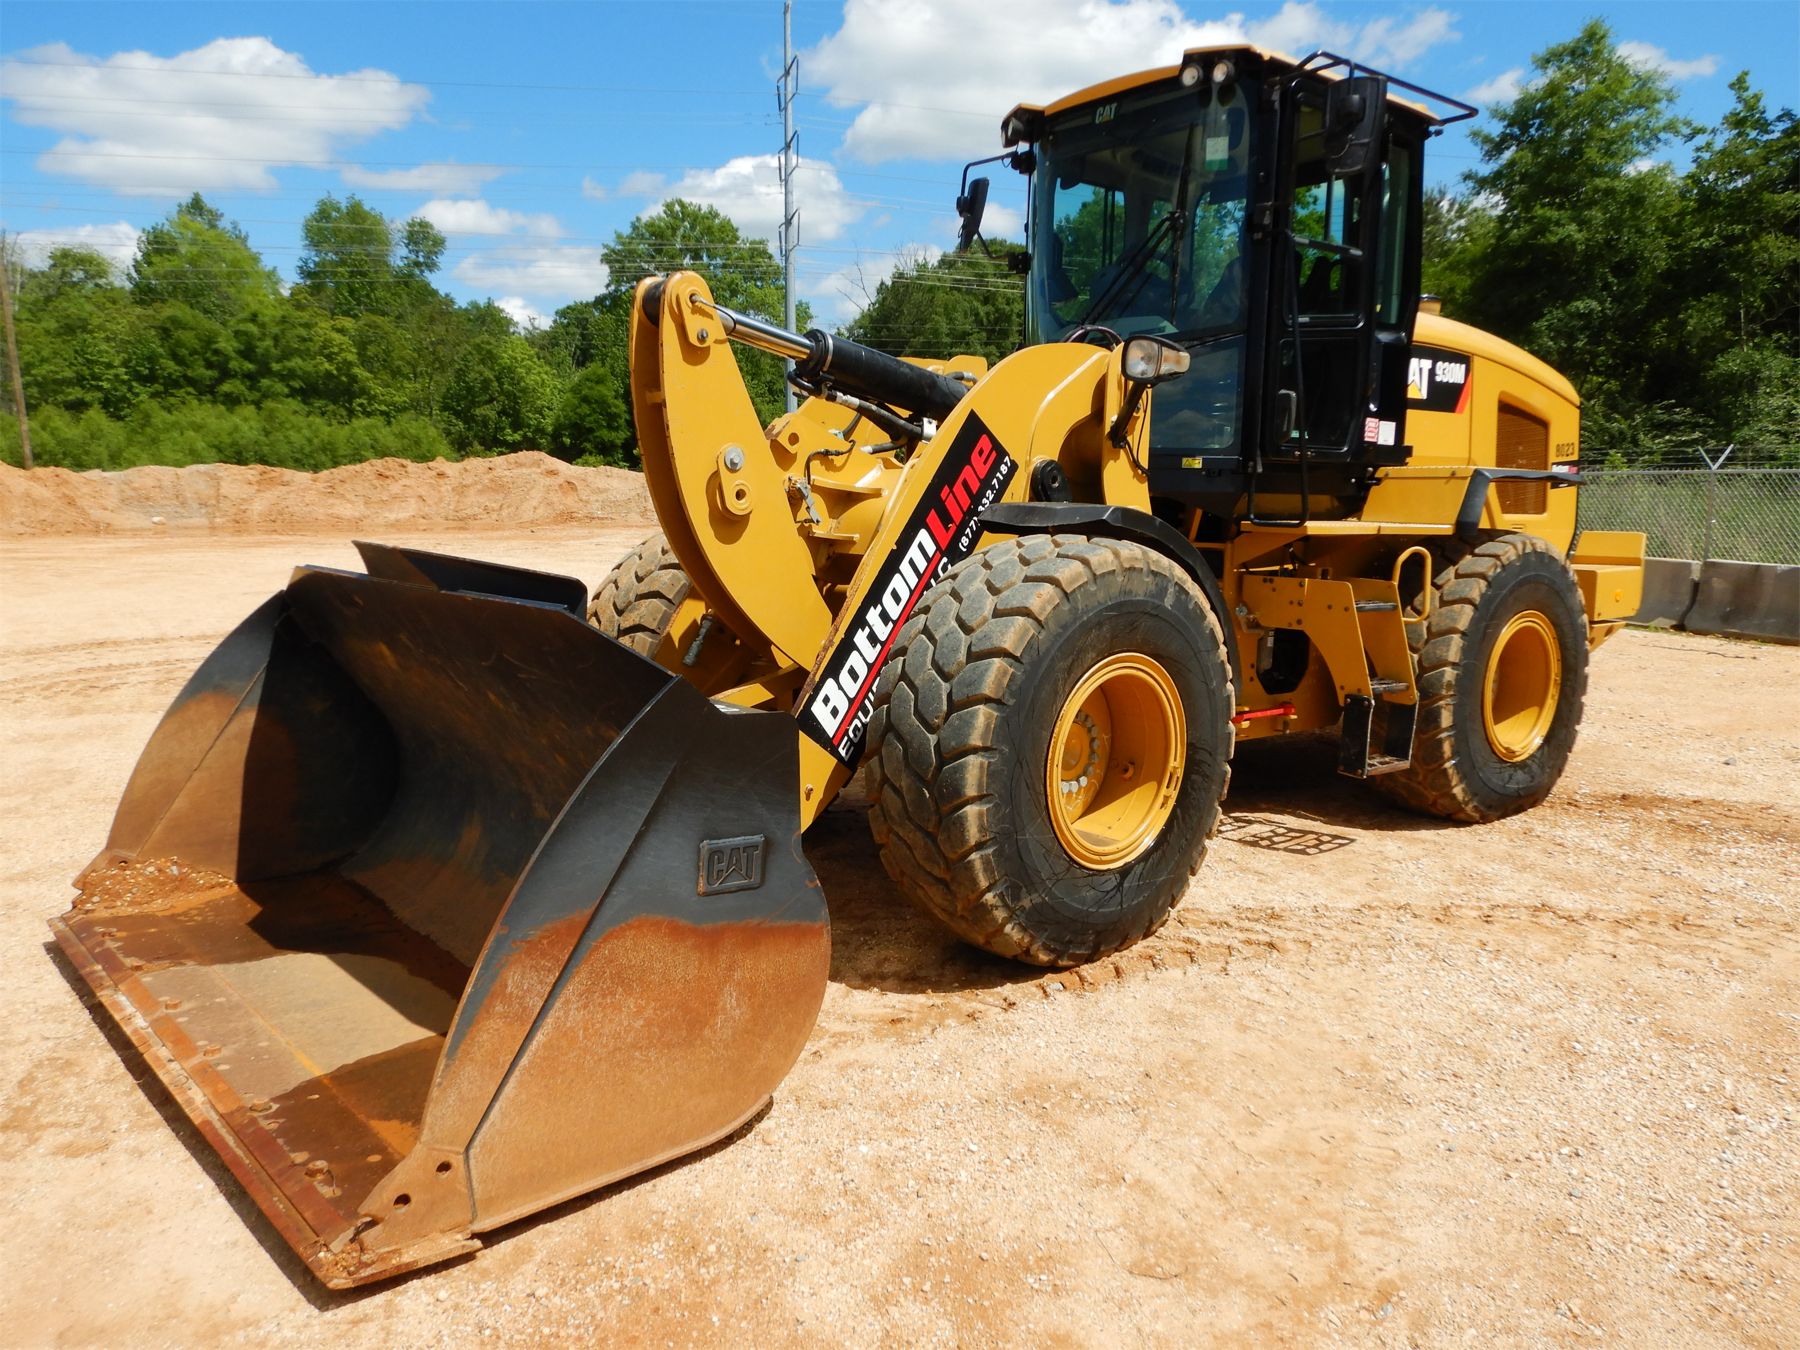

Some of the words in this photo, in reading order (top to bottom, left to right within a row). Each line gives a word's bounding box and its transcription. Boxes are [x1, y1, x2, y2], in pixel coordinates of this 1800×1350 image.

[1095, 102, 1118, 124] CAT
[1406, 357, 1433, 400] AT
[1434, 360, 1466, 385] 930M
[707, 845, 760, 888] CAT
